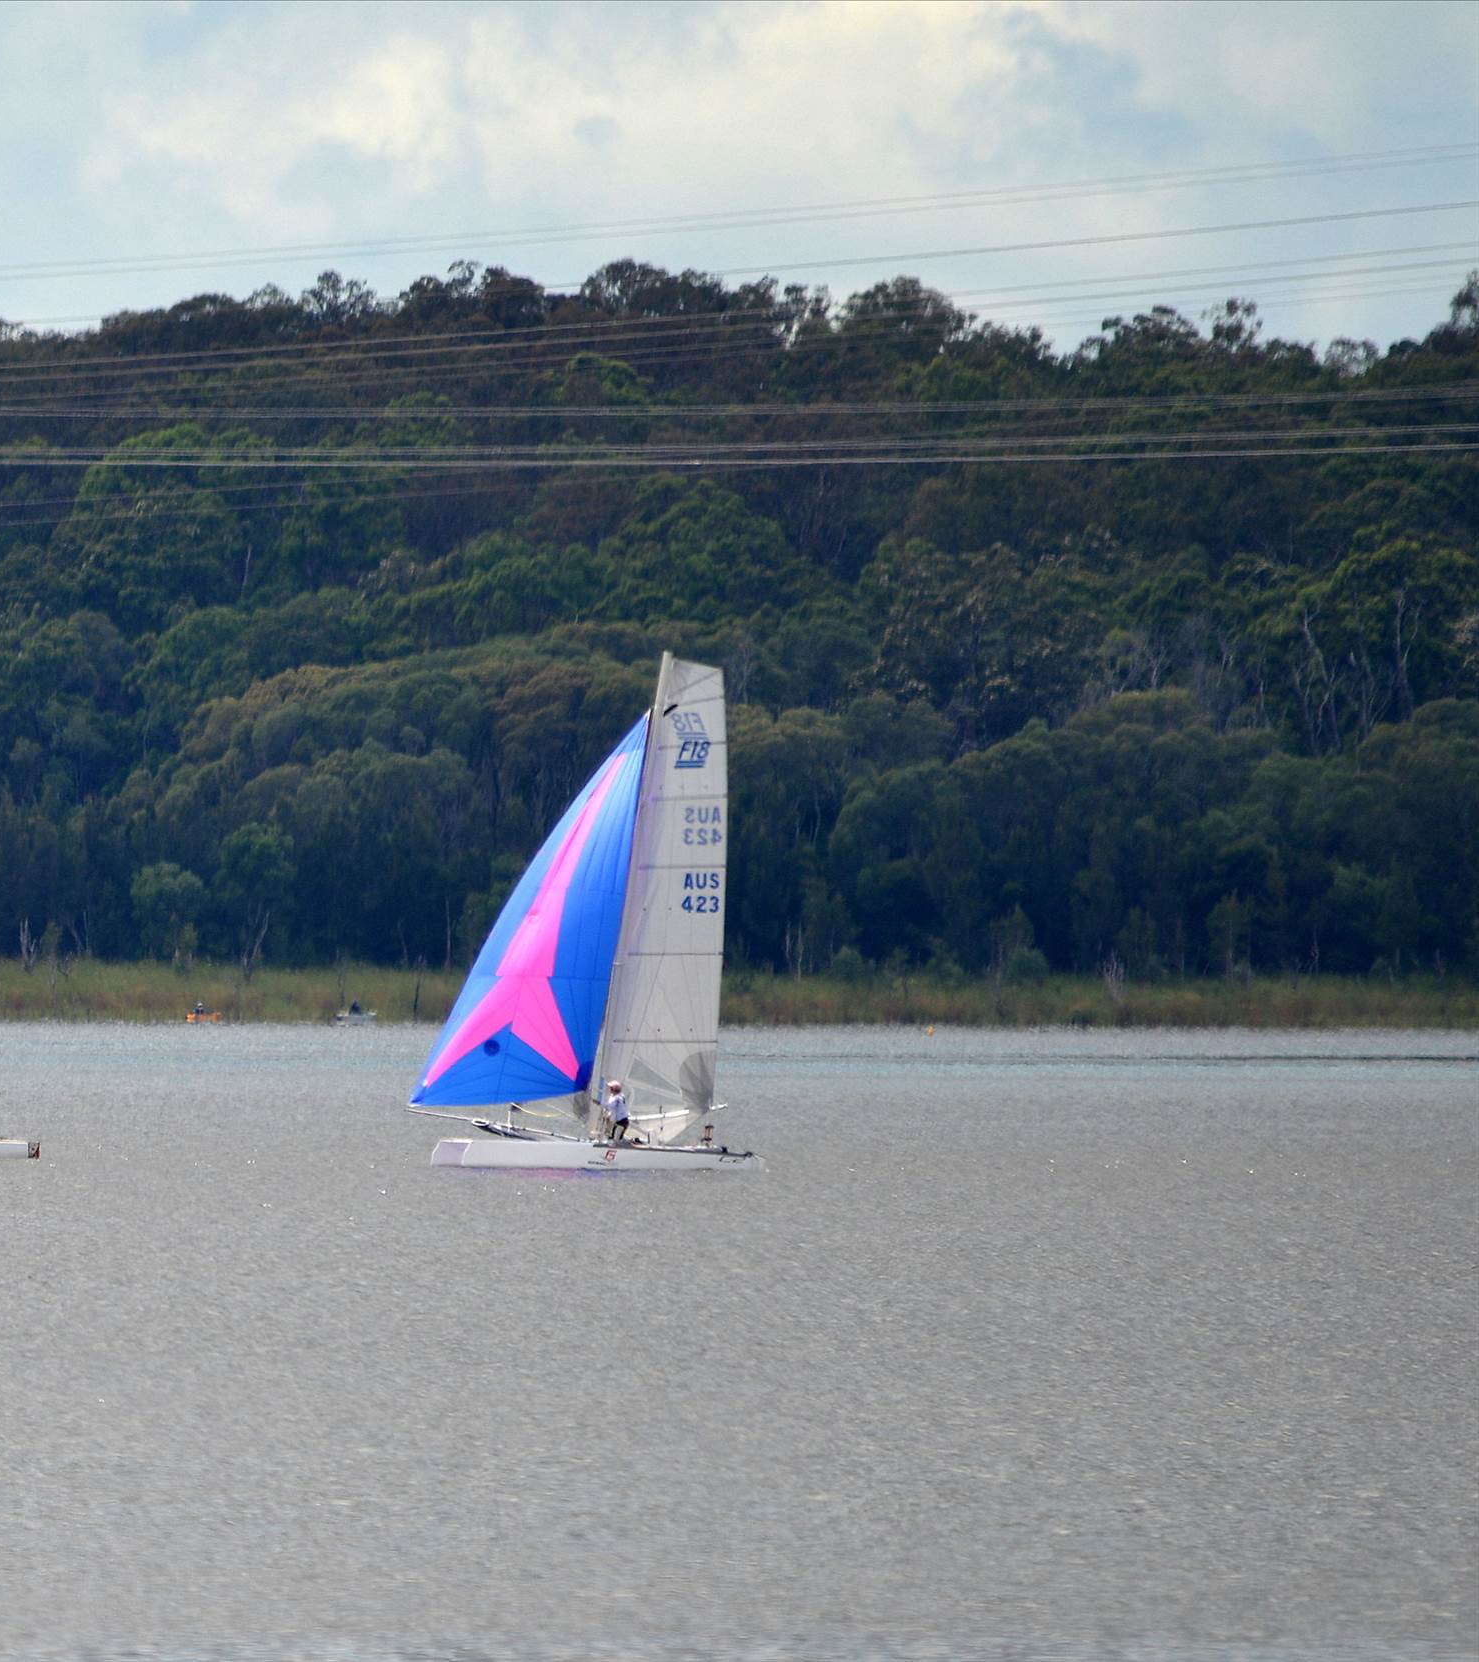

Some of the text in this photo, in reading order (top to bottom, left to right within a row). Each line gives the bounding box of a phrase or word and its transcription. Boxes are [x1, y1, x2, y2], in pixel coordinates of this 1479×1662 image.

[678, 741, 711, 760] F18
[684, 873, 720, 890] AUS
[681, 896, 720, 913] 423
